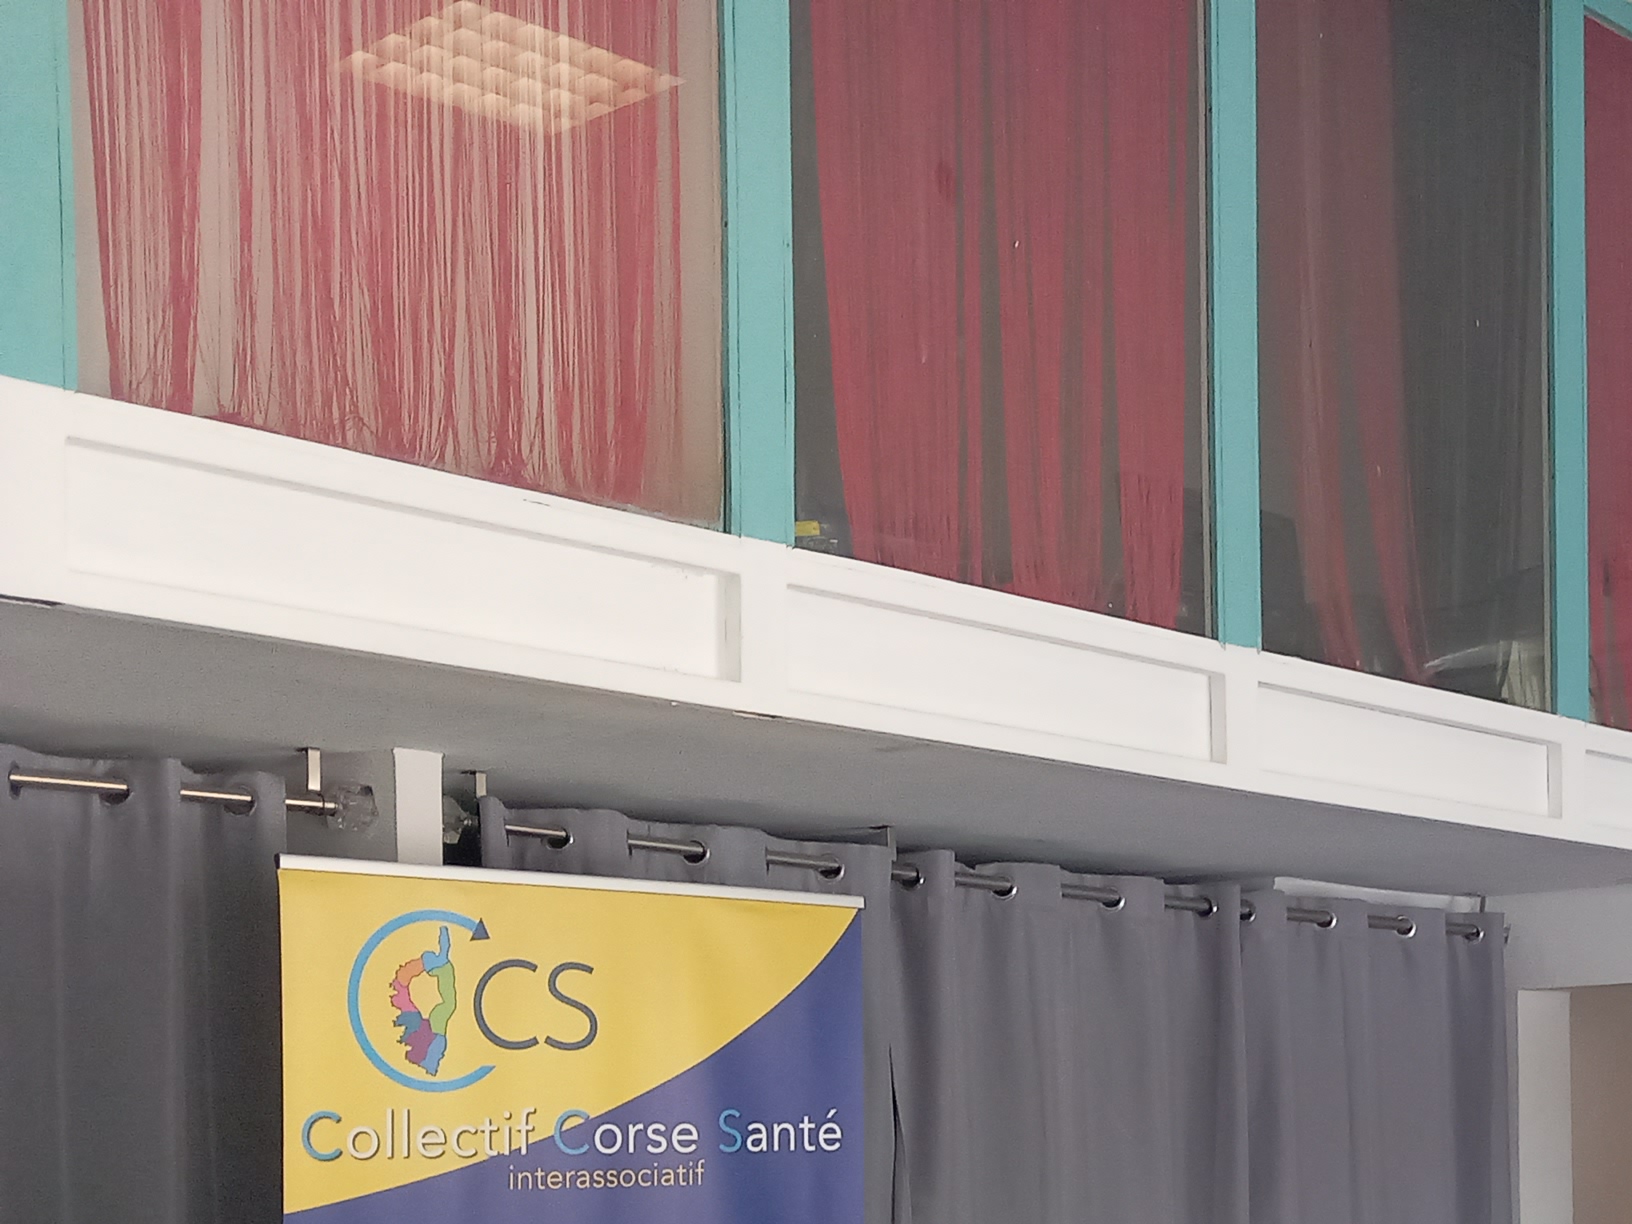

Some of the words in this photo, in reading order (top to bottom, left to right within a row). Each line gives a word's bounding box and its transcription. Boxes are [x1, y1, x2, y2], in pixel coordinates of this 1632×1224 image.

[301, 1106, 535, 1162] Collectif
[554, 1108, 699, 1156] Corse
[719, 1107, 842, 1155] Santé
[508, 1160, 706, 1191] interassociatif
